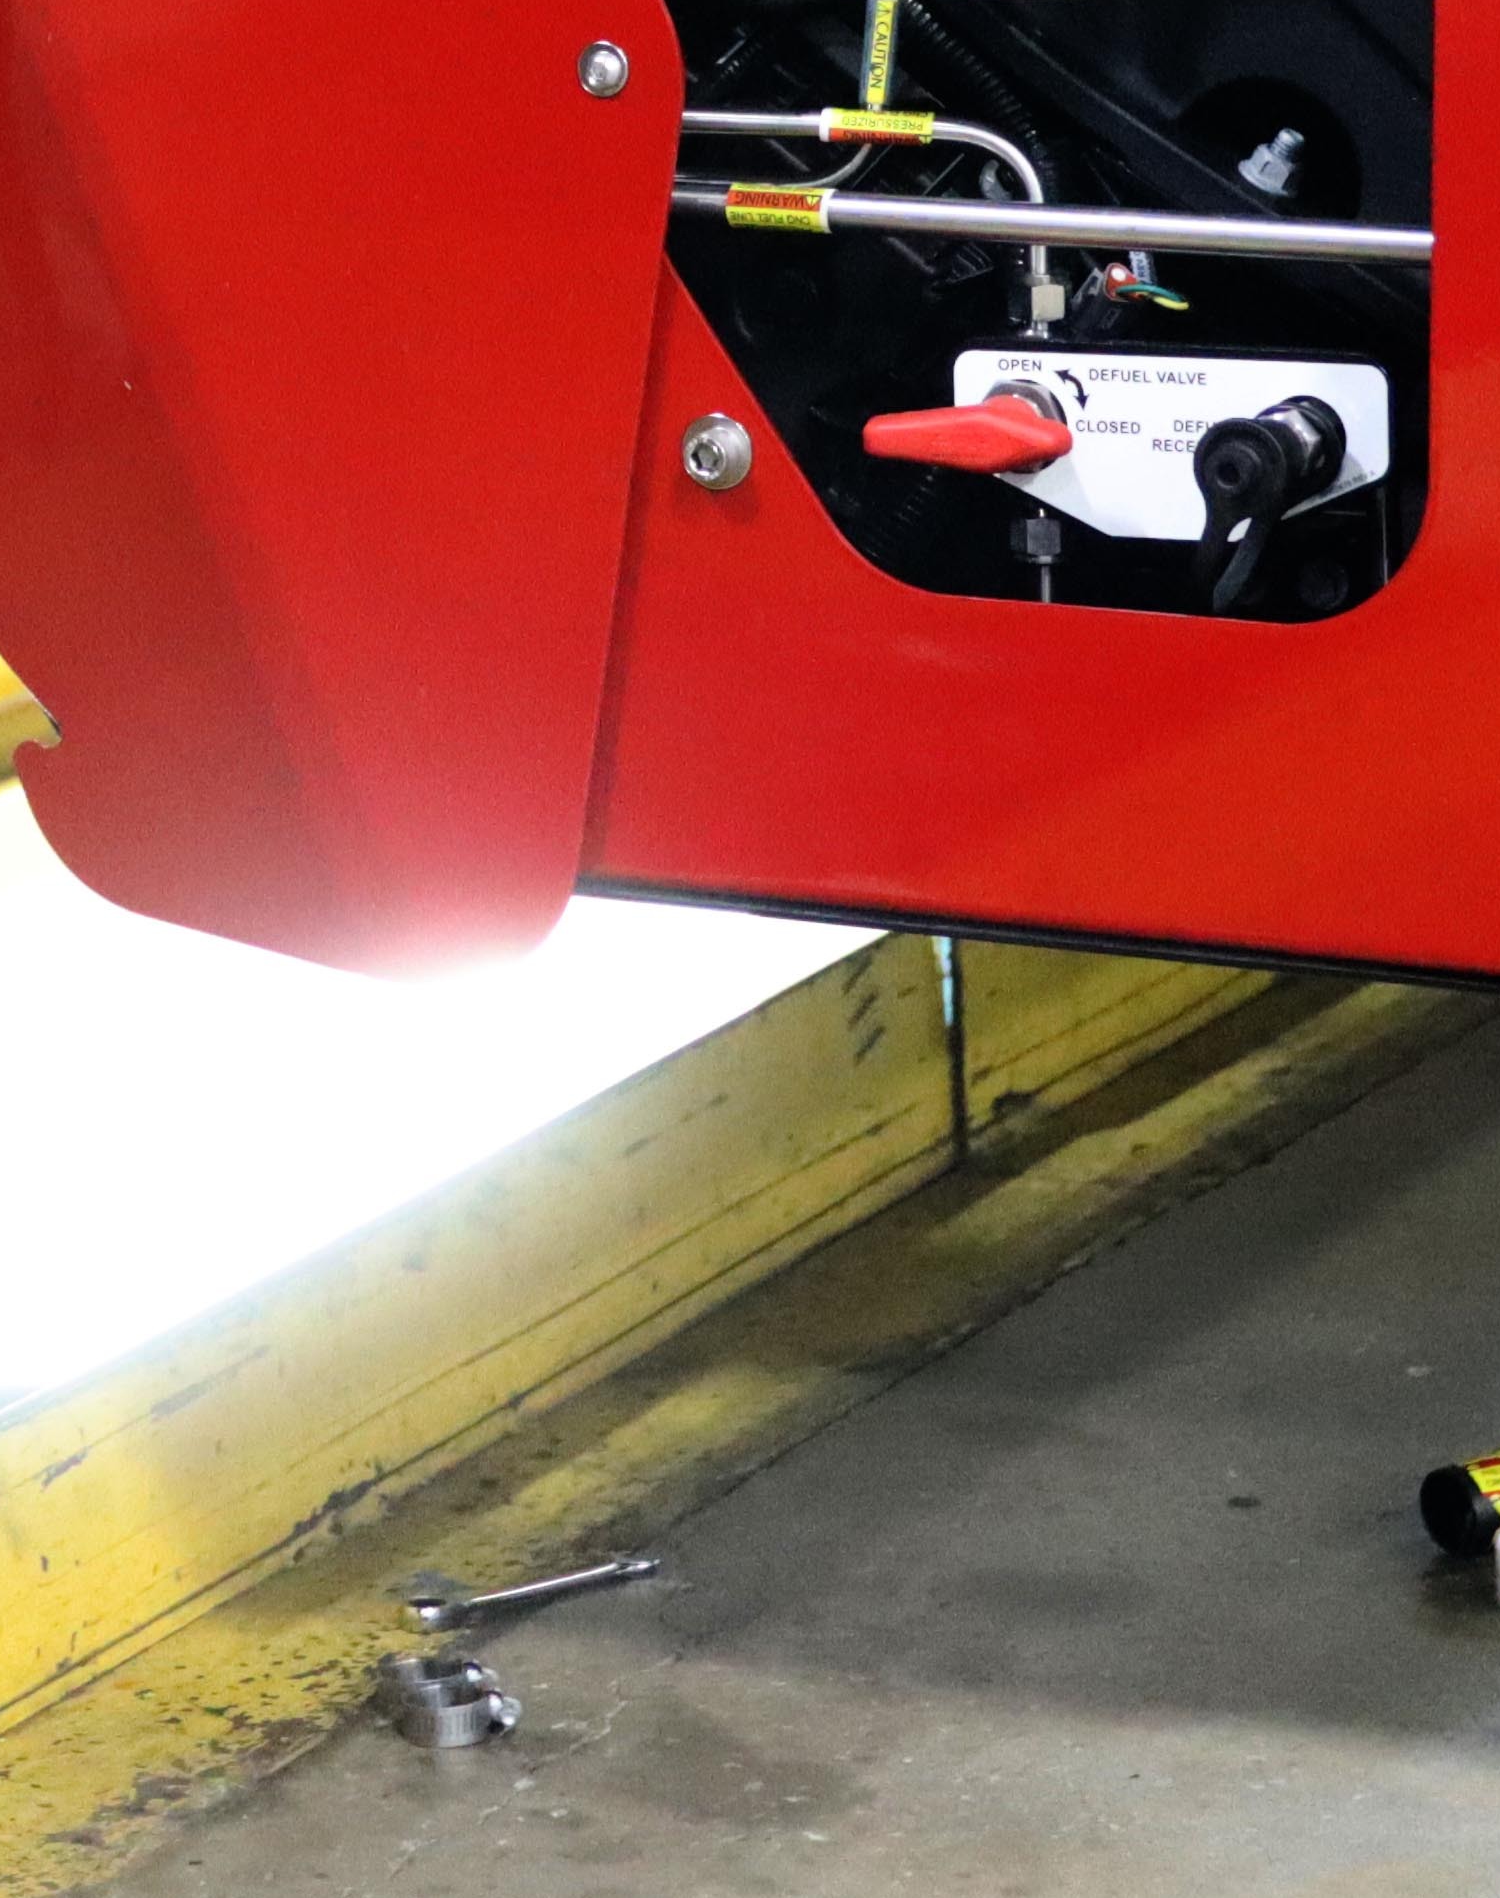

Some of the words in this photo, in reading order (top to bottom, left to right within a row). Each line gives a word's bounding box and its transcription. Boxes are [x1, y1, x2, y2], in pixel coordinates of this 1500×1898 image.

[869, 21, 889, 89] CAUTION
[842, 116, 923, 131] PRESSURIZED
[736, 191, 804, 206] WARNING
[730, 211, 754, 222] LINE
[759, 213, 782, 223] FUEL
[787, 215, 810, 226] CNG
[998, 358, 1042, 372] OPEN
[1089, 368, 1151, 383] DEFUEL
[1156, 372, 1207, 386] VALVE
[1076, 420, 1141, 434] CLOSED
